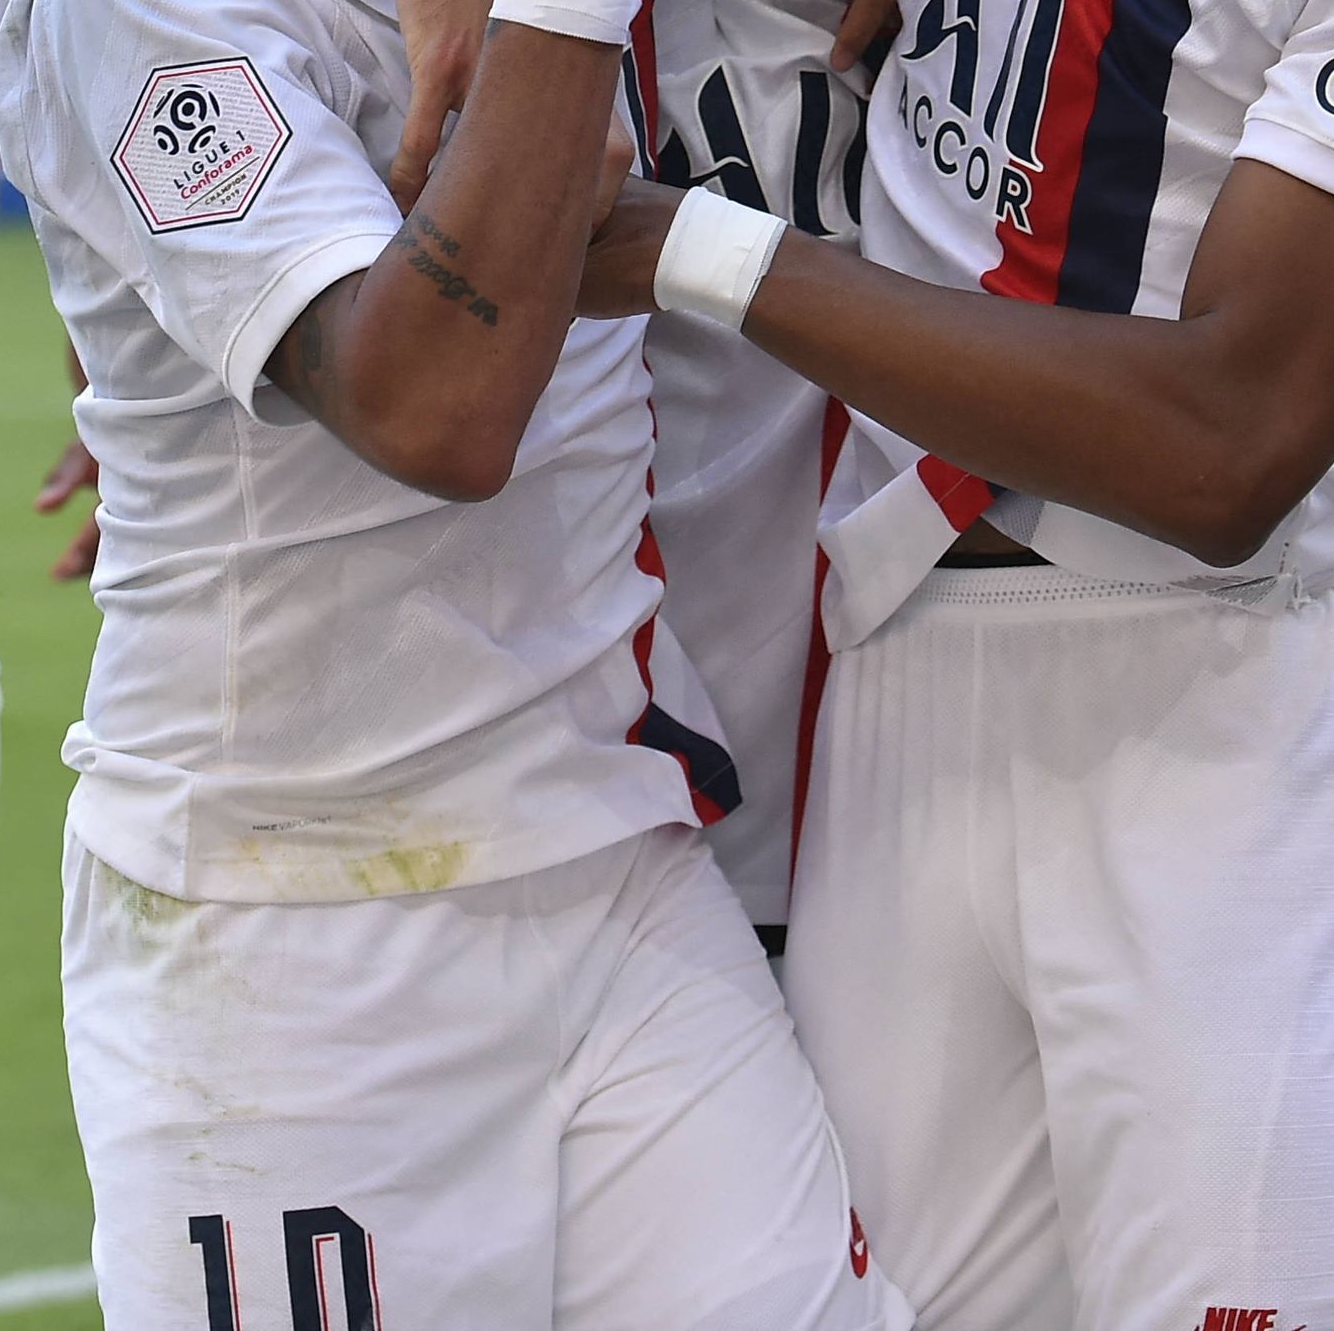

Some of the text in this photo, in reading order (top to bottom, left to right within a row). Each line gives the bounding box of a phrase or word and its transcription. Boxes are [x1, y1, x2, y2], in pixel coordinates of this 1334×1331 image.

[173, 130, 246, 190] LIGUE 1
[180, 145, 254, 200] Conforama
[897, 73, 1033, 236] ACCOR
[204, 173, 248, 206] CHAMPION
[188, 1205, 381, 1331] 10
[1203, 1306, 1278, 1331] NIKE
